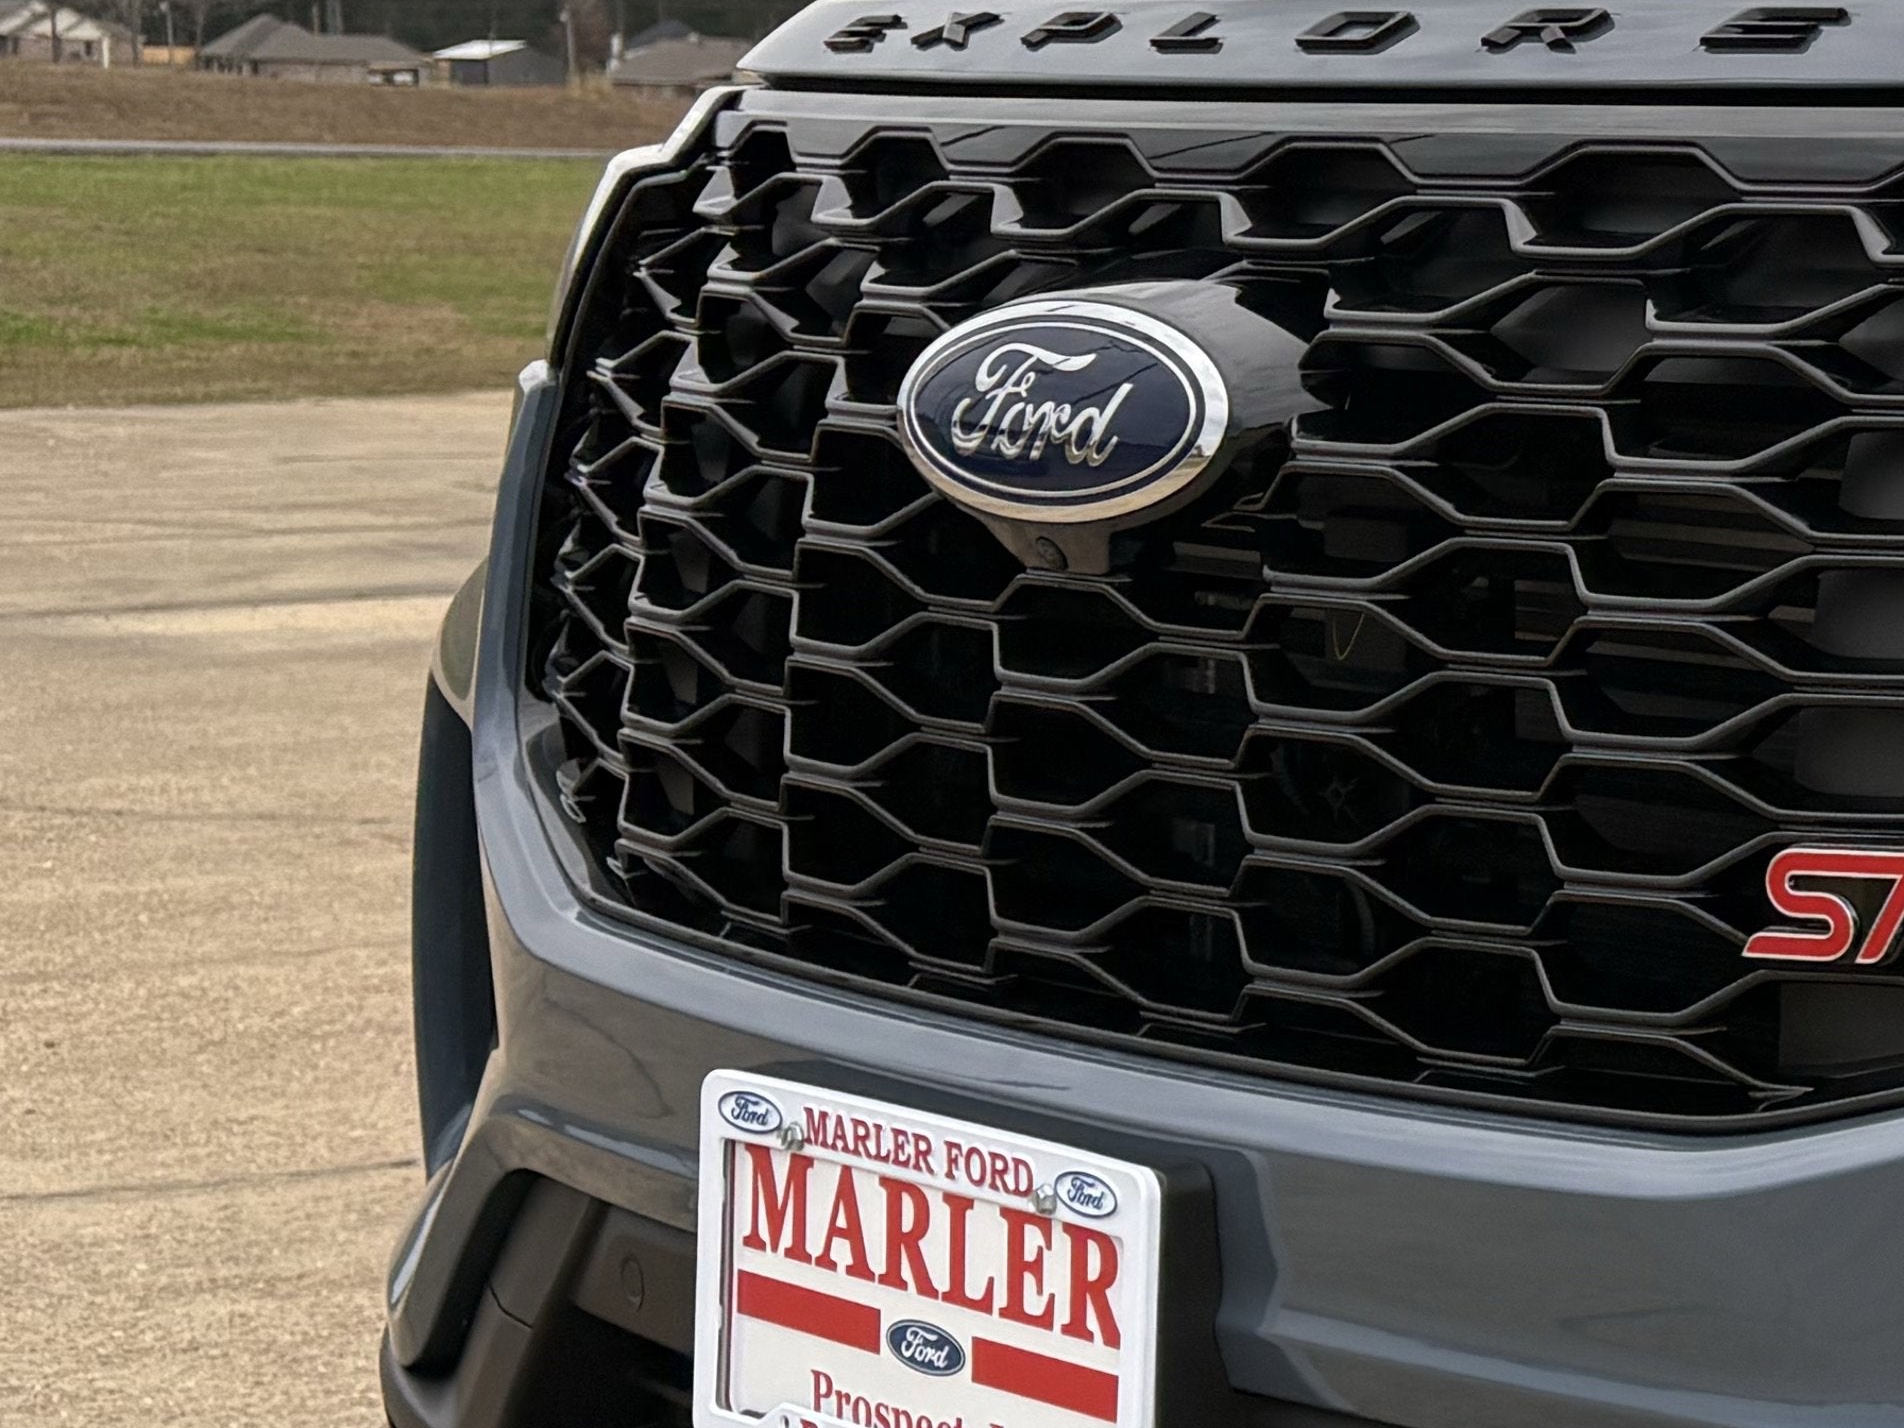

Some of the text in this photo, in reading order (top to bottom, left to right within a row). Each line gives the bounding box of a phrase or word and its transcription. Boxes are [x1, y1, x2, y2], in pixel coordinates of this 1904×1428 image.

[951, 342, 1134, 467] Ford
[804, 1106, 1034, 1198] MARLER FORD
[741, 1143, 1121, 1350] MARLER
